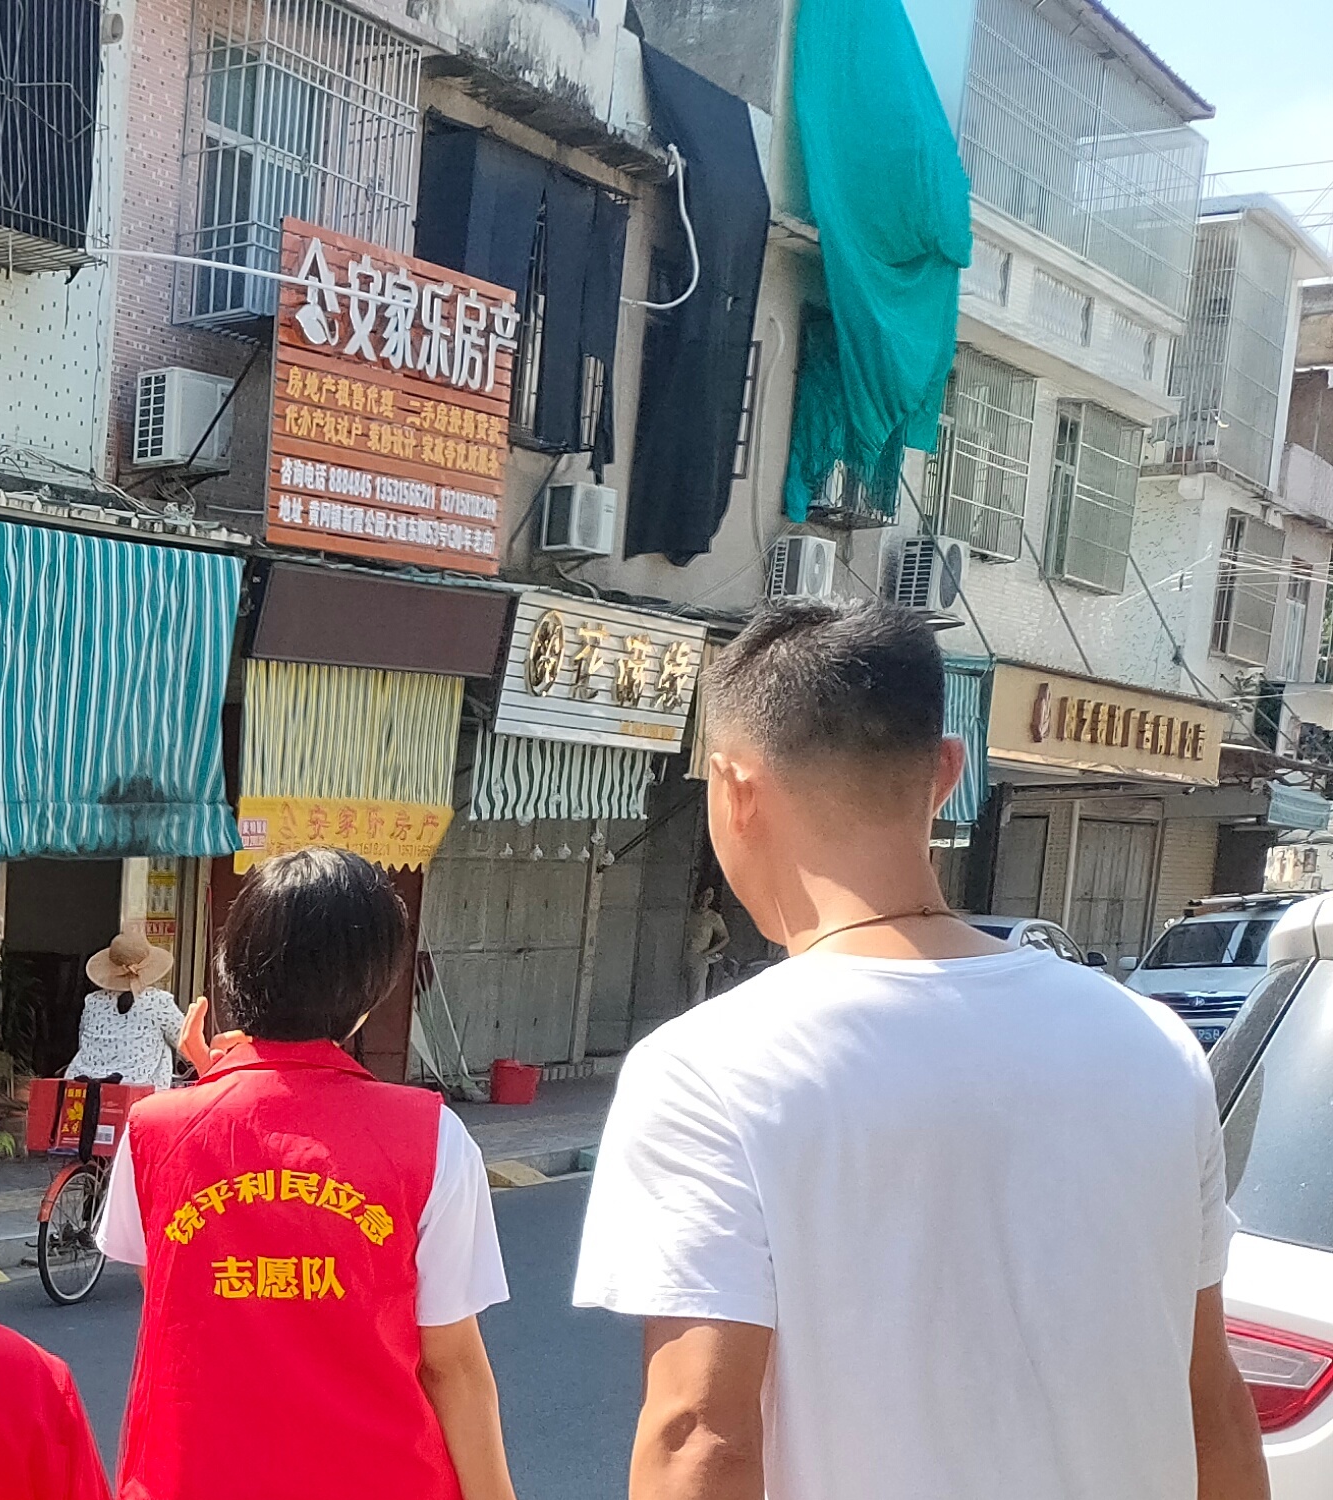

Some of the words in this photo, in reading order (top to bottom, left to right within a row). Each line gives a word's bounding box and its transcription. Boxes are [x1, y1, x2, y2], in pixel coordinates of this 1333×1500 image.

[344, 254, 520, 392] 安家乐房产
[164, 1169, 396, 1246] 饶平利民应急
[211, 1256, 345, 1300] 志愿队
